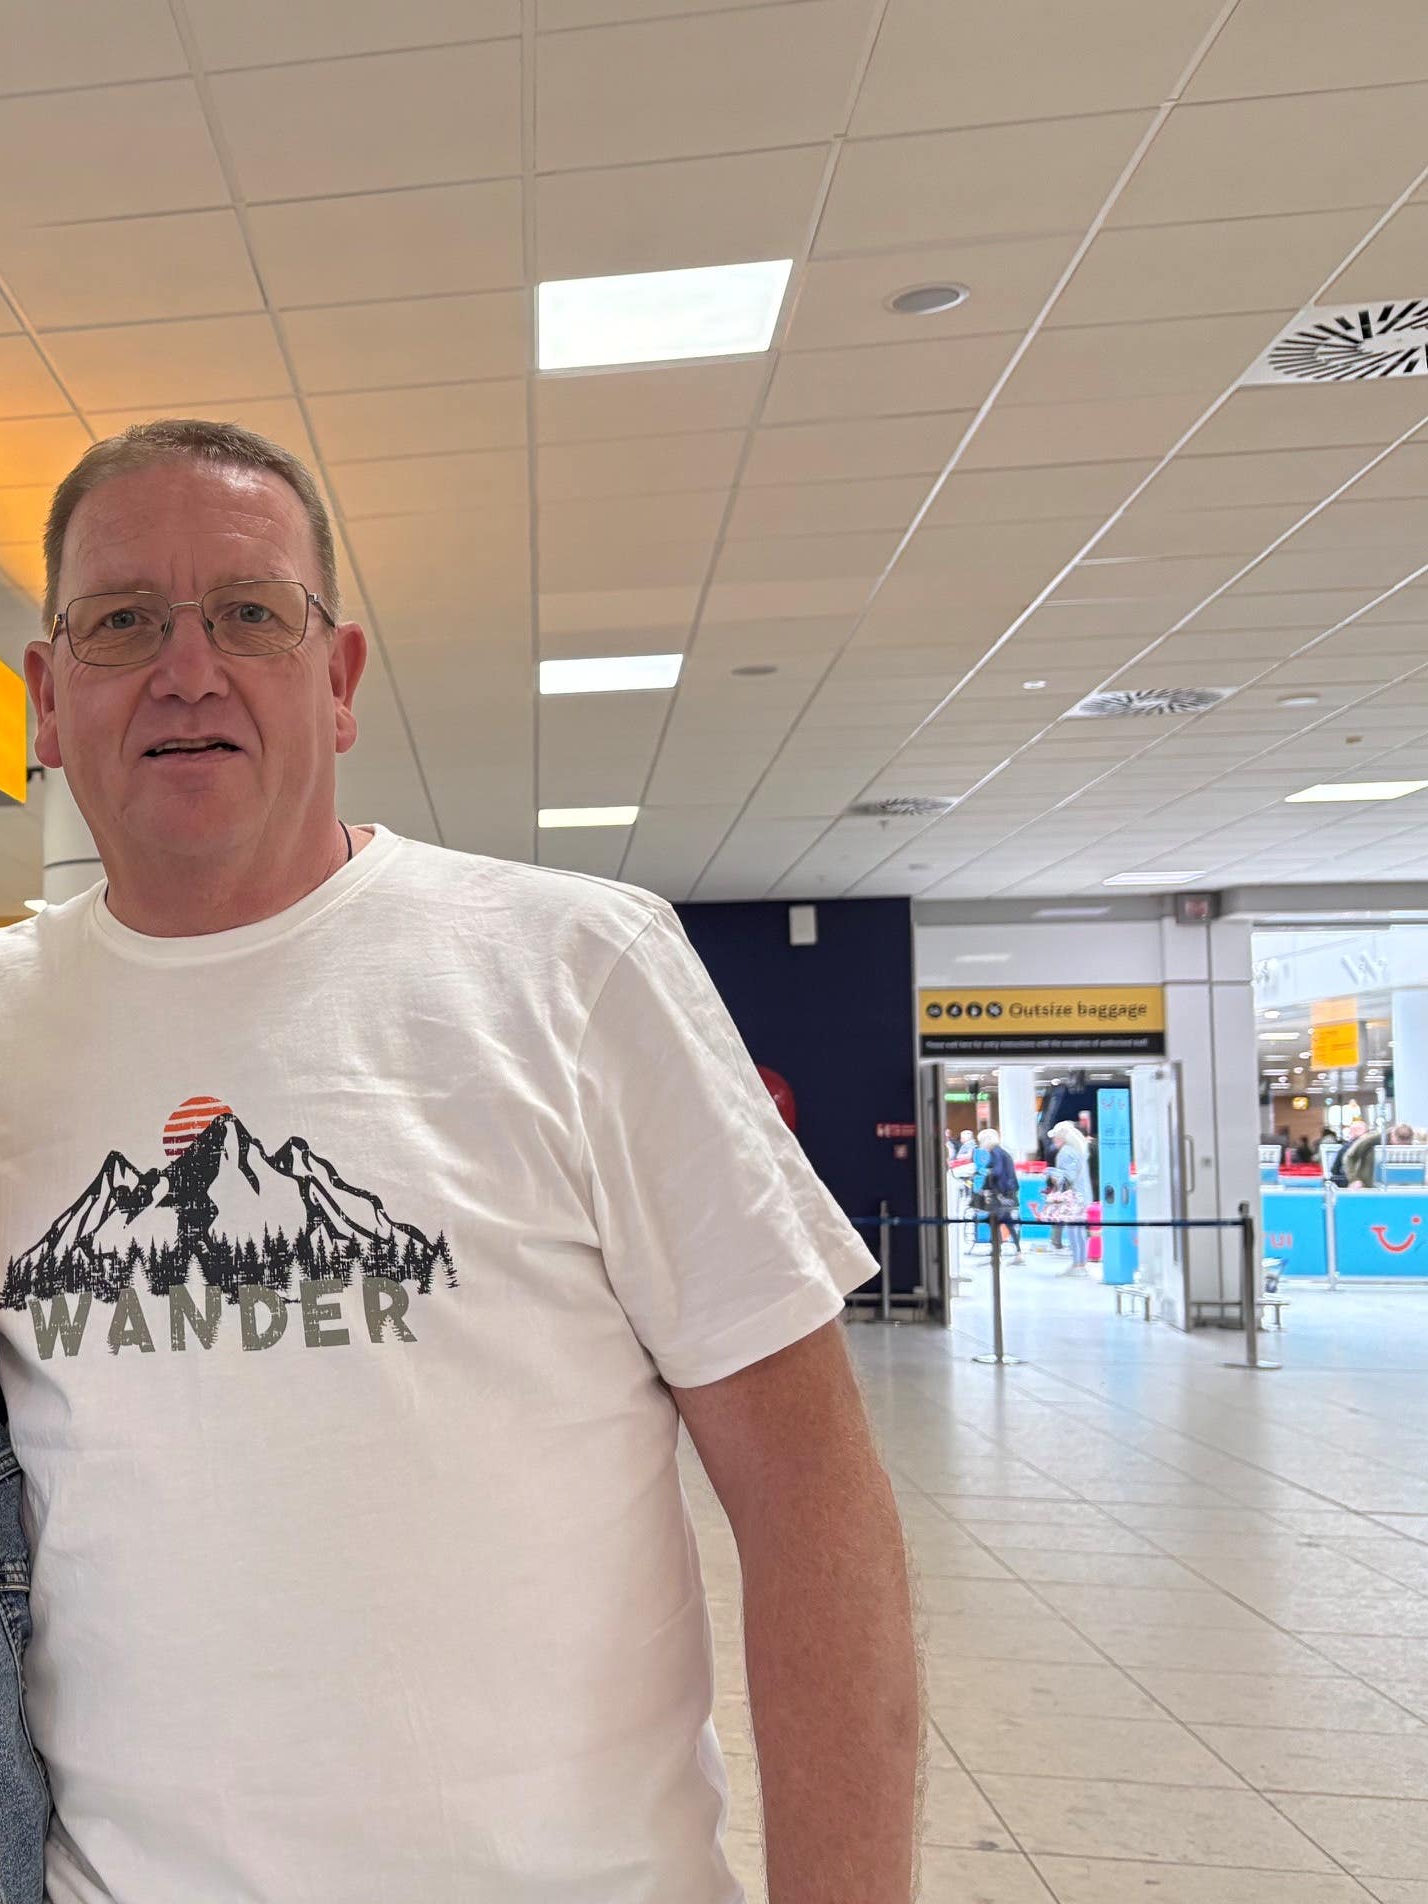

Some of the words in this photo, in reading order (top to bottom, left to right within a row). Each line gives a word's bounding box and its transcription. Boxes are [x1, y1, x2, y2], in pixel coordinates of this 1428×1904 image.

[1009, 1002, 1072, 1018] Outsize
[1077, 1001, 1147, 1020] baggage
[28, 1277, 418, 1361] WANDER
